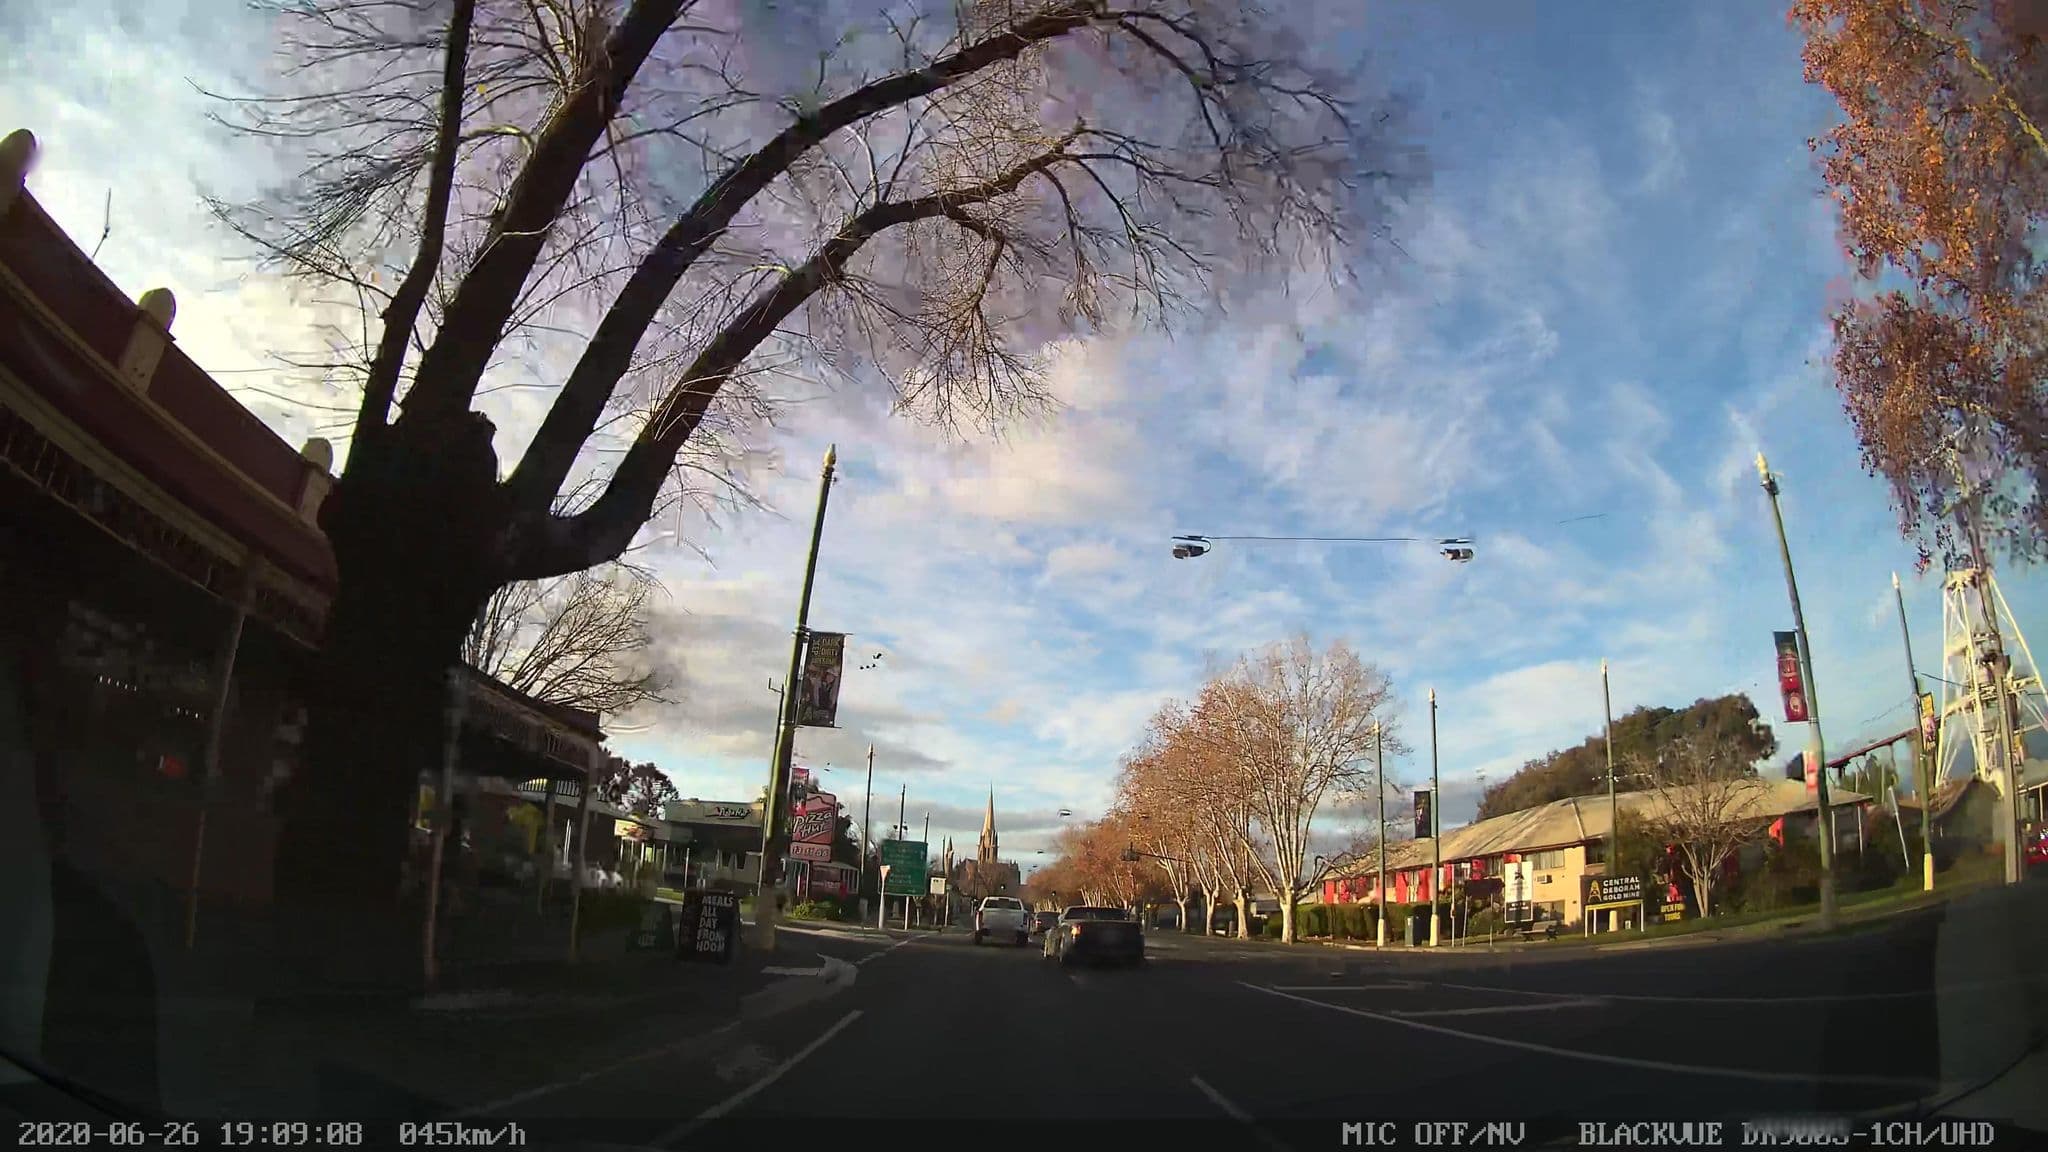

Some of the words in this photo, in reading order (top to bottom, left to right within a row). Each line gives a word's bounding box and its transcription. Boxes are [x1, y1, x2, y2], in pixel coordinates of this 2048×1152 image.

[793, 811, 833, 833] Pizza
[801, 822, 825, 839] Hut
[1603, 876, 1640, 887] CENTRAL
[1603, 884, 1640, 894] DEBORAH
[702, 896, 733, 907] MEALS
[1603, 892, 1622, 901] GOLD
[702, 906, 716, 917] ALL
[699, 917, 718, 929] DAY
